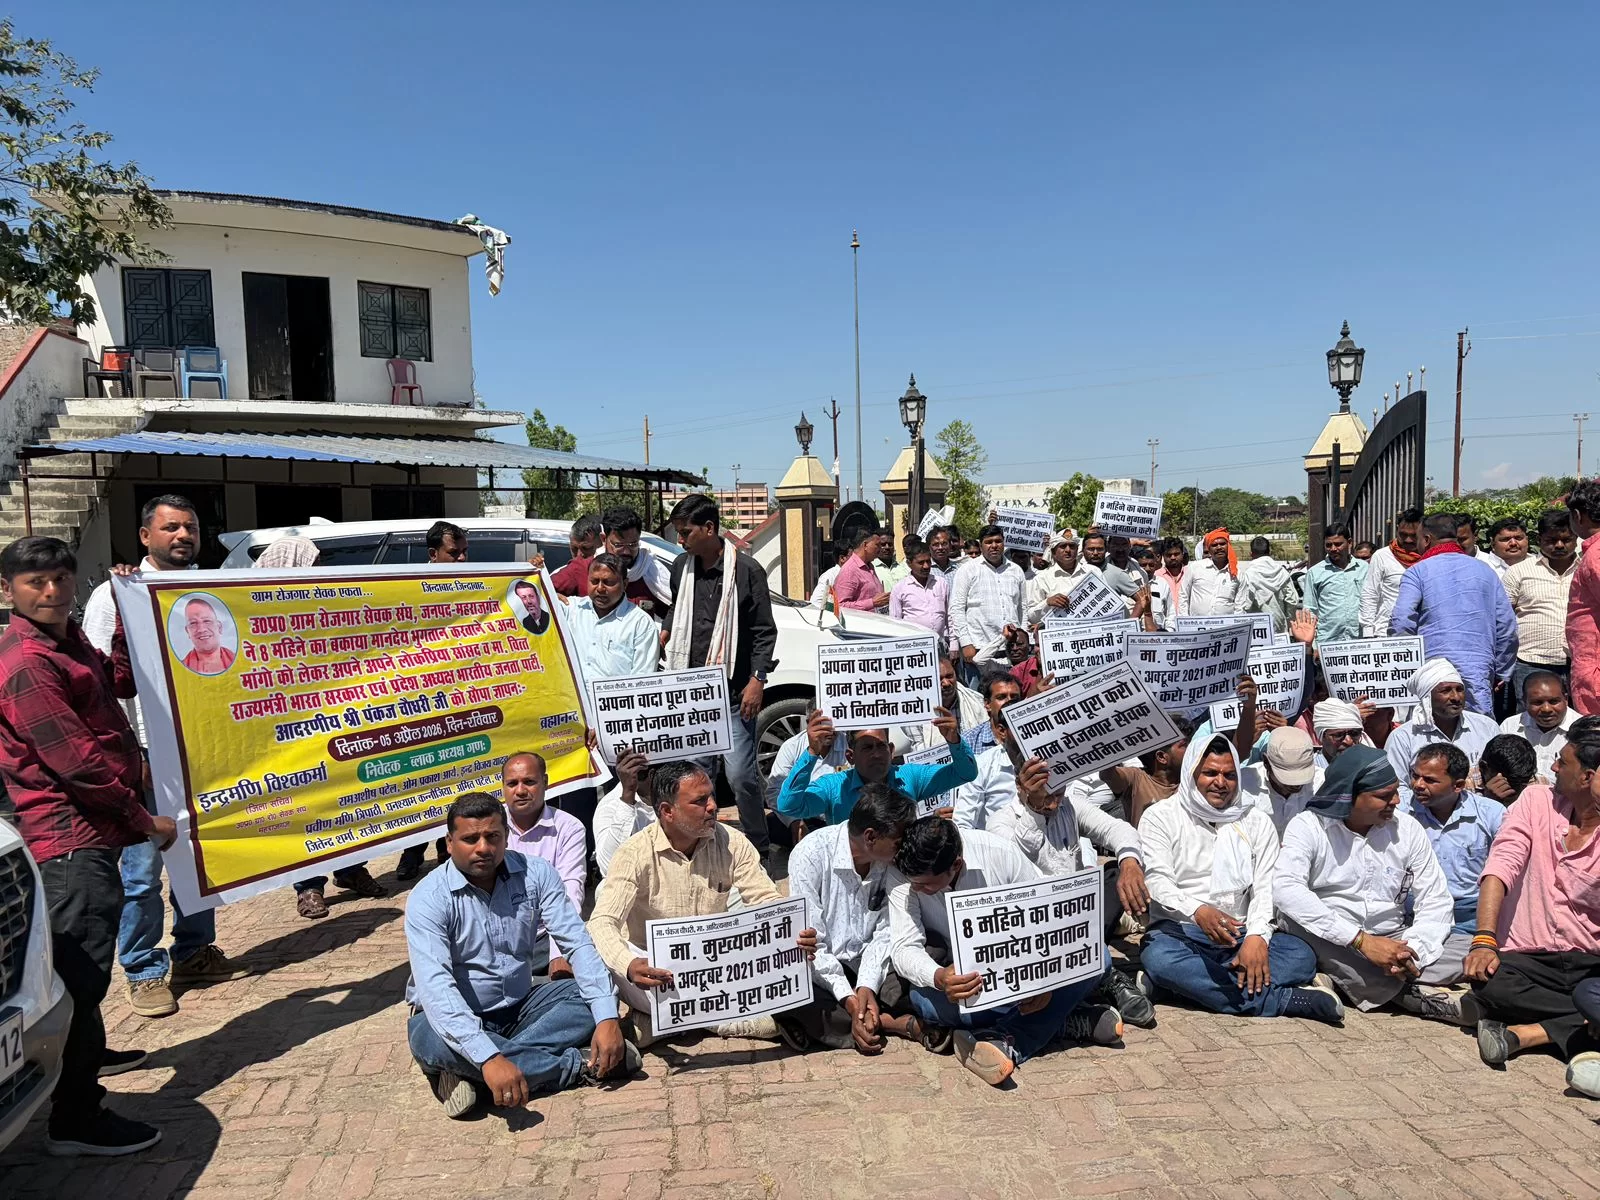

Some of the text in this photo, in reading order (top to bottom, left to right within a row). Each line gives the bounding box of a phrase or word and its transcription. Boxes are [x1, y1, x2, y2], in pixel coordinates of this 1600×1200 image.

[290, 613, 315, 630] ग्राम
[318, 608, 361, 628] रोजगार
[364, 605, 392, 625] सेवक
[395, 602, 419, 624] संघ,
[244, 618, 518, 662] ने 8 महिने का बकाया मानदेय भुगतान करवाने व अन्य
[1140, 650, 1160, 663] मा.
[1166, 643, 1221, 665] मुख्यमंत्री
[1223, 638, 1238, 654] जी
[276, 664, 294, 686] को
[298, 663, 330, 683] लेकर
[332, 657, 362, 679] अपने
[366, 652, 397, 674] अपने
[398, 647, 449, 669] लोकप्रिया
[452, 641, 481, 661] सांसद
[483, 643, 490, 656] व
[492, 640, 508, 656] मा.
[821, 657, 904, 675] अपना वादा पूरा
[1265, 664, 1280, 678] पूरा
[1325, 653, 1390, 668] अपना वादा पूरा
[230, 654, 544, 720] राज्यमंत्री भारत सरकार एवं प्रदेश अध्यक्ष भारतीय जनता पार्टी,
[826, 674, 933, 698] ग्राम रोजगार सेवक
[1281, 677, 1299, 691] सेवक
[1330, 672, 1348, 684] ग्राम
[1350, 668, 1389, 684] रोजगार
[276, 688, 466, 742] आदरणीय श्री पंकज चौधरी जी को
[598, 689, 687, 712] अपना वादा पूरा
[832, 700, 900, 720] को नियमित
[605, 708, 720, 736] ग्राम रोजगार सेवक
[1017, 695, 1102, 741] अपना वादा पूरा
[1033, 702, 1151, 761] ग्राम रोजगार सेवक
[379, 737, 392, 748] 05
[1069, 737, 1125, 768] नियमित
[365, 745, 465, 778] निवेदक ब्लाक अध्यक्ष
[198, 762, 327, 812] इन्द्रमणि विश्वकर्मा
[962, 892, 1096, 939] 8 महिने का बकाया
[669, 916, 792, 962] मा. मुख्यमंत्री जी
[973, 921, 1089, 965] मानदेय भुगतान
[678, 946, 804, 992] अक्टूबर 2021 का घोषणा
[669, 999, 696, 1024] पूरा
